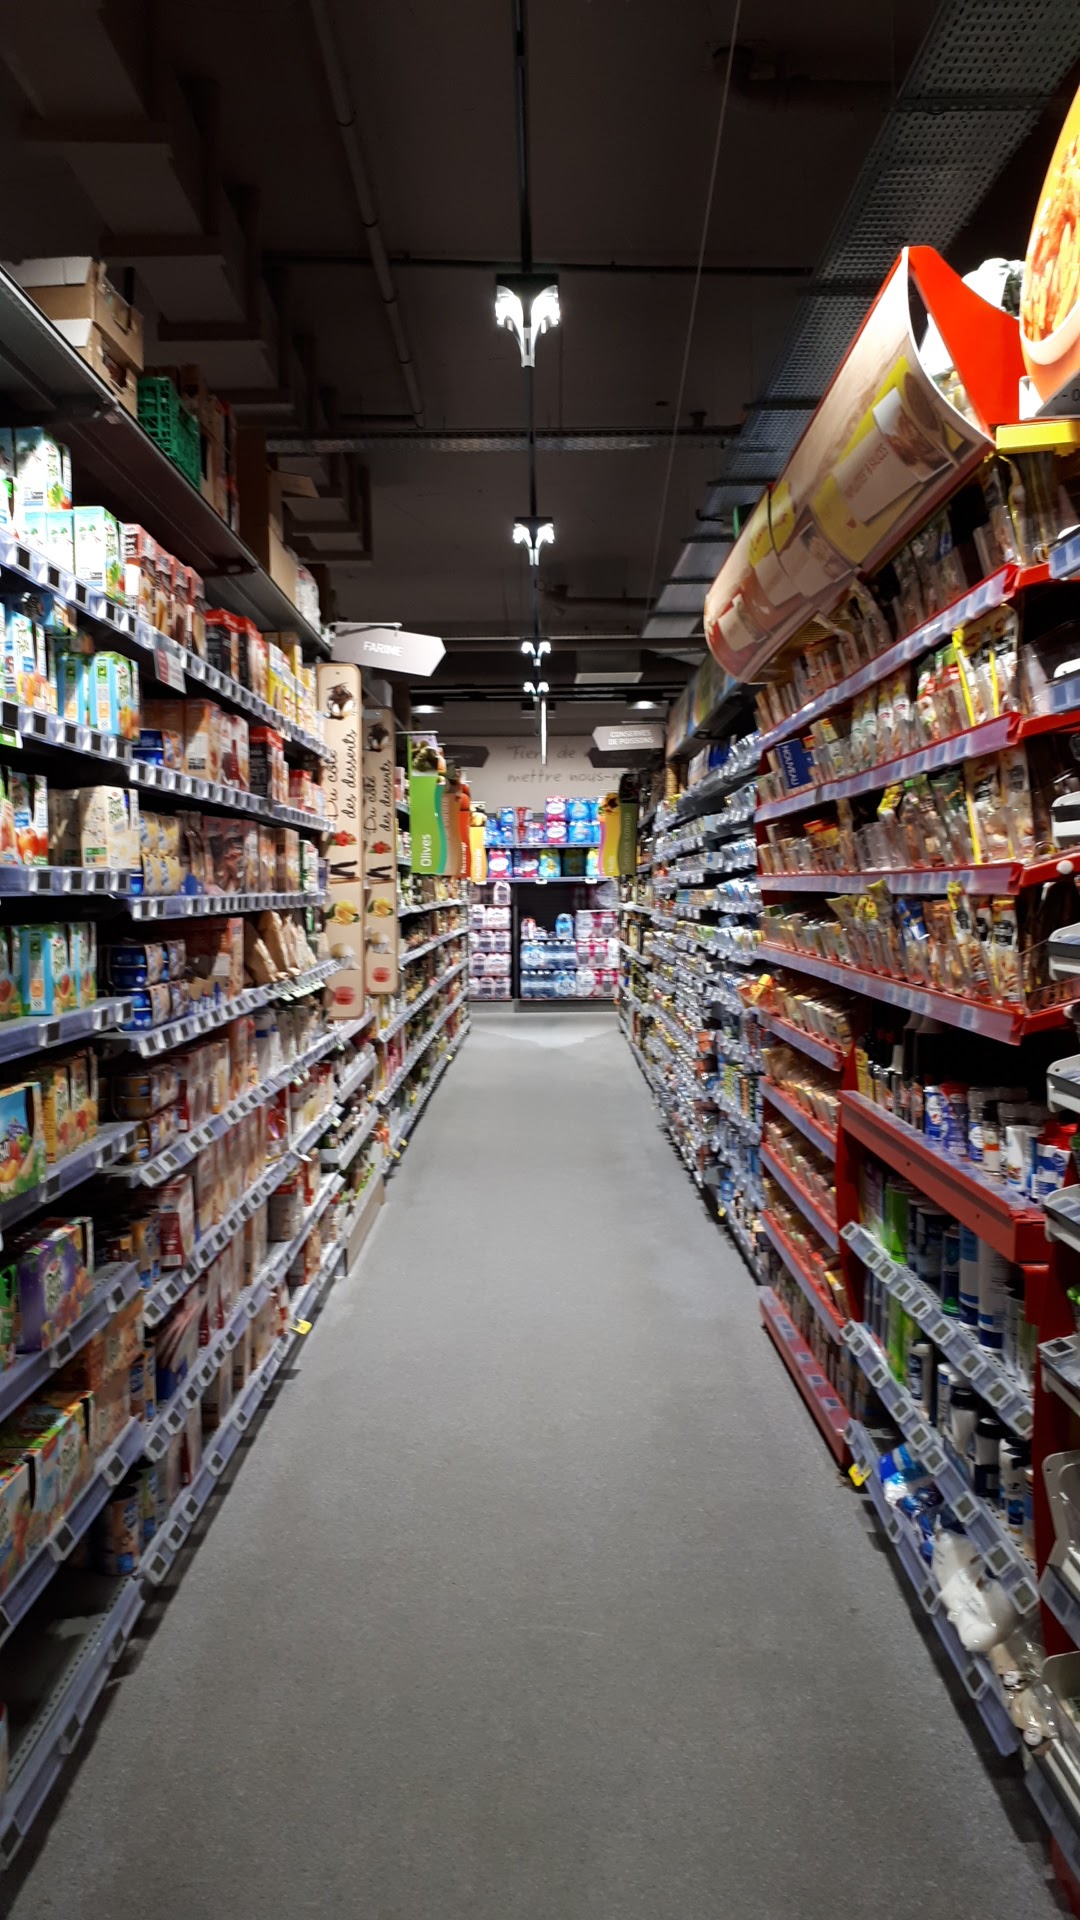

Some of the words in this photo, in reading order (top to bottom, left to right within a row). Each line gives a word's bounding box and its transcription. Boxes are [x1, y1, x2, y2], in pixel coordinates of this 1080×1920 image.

[363, 641, 404, 657] FARINE
[607, 738, 618, 746] DE
[619, 736, 654, 745] POISSONS
[609, 729, 652, 738] CONSERVES
[341, 729, 357, 788] desserts
[780, 745, 799, 786] NOUVEAU
[379, 759, 392, 807] desserts
[341, 793, 356, 819] des
[379, 811, 391, 832] des
[420, 834, 432, 867] Olives
